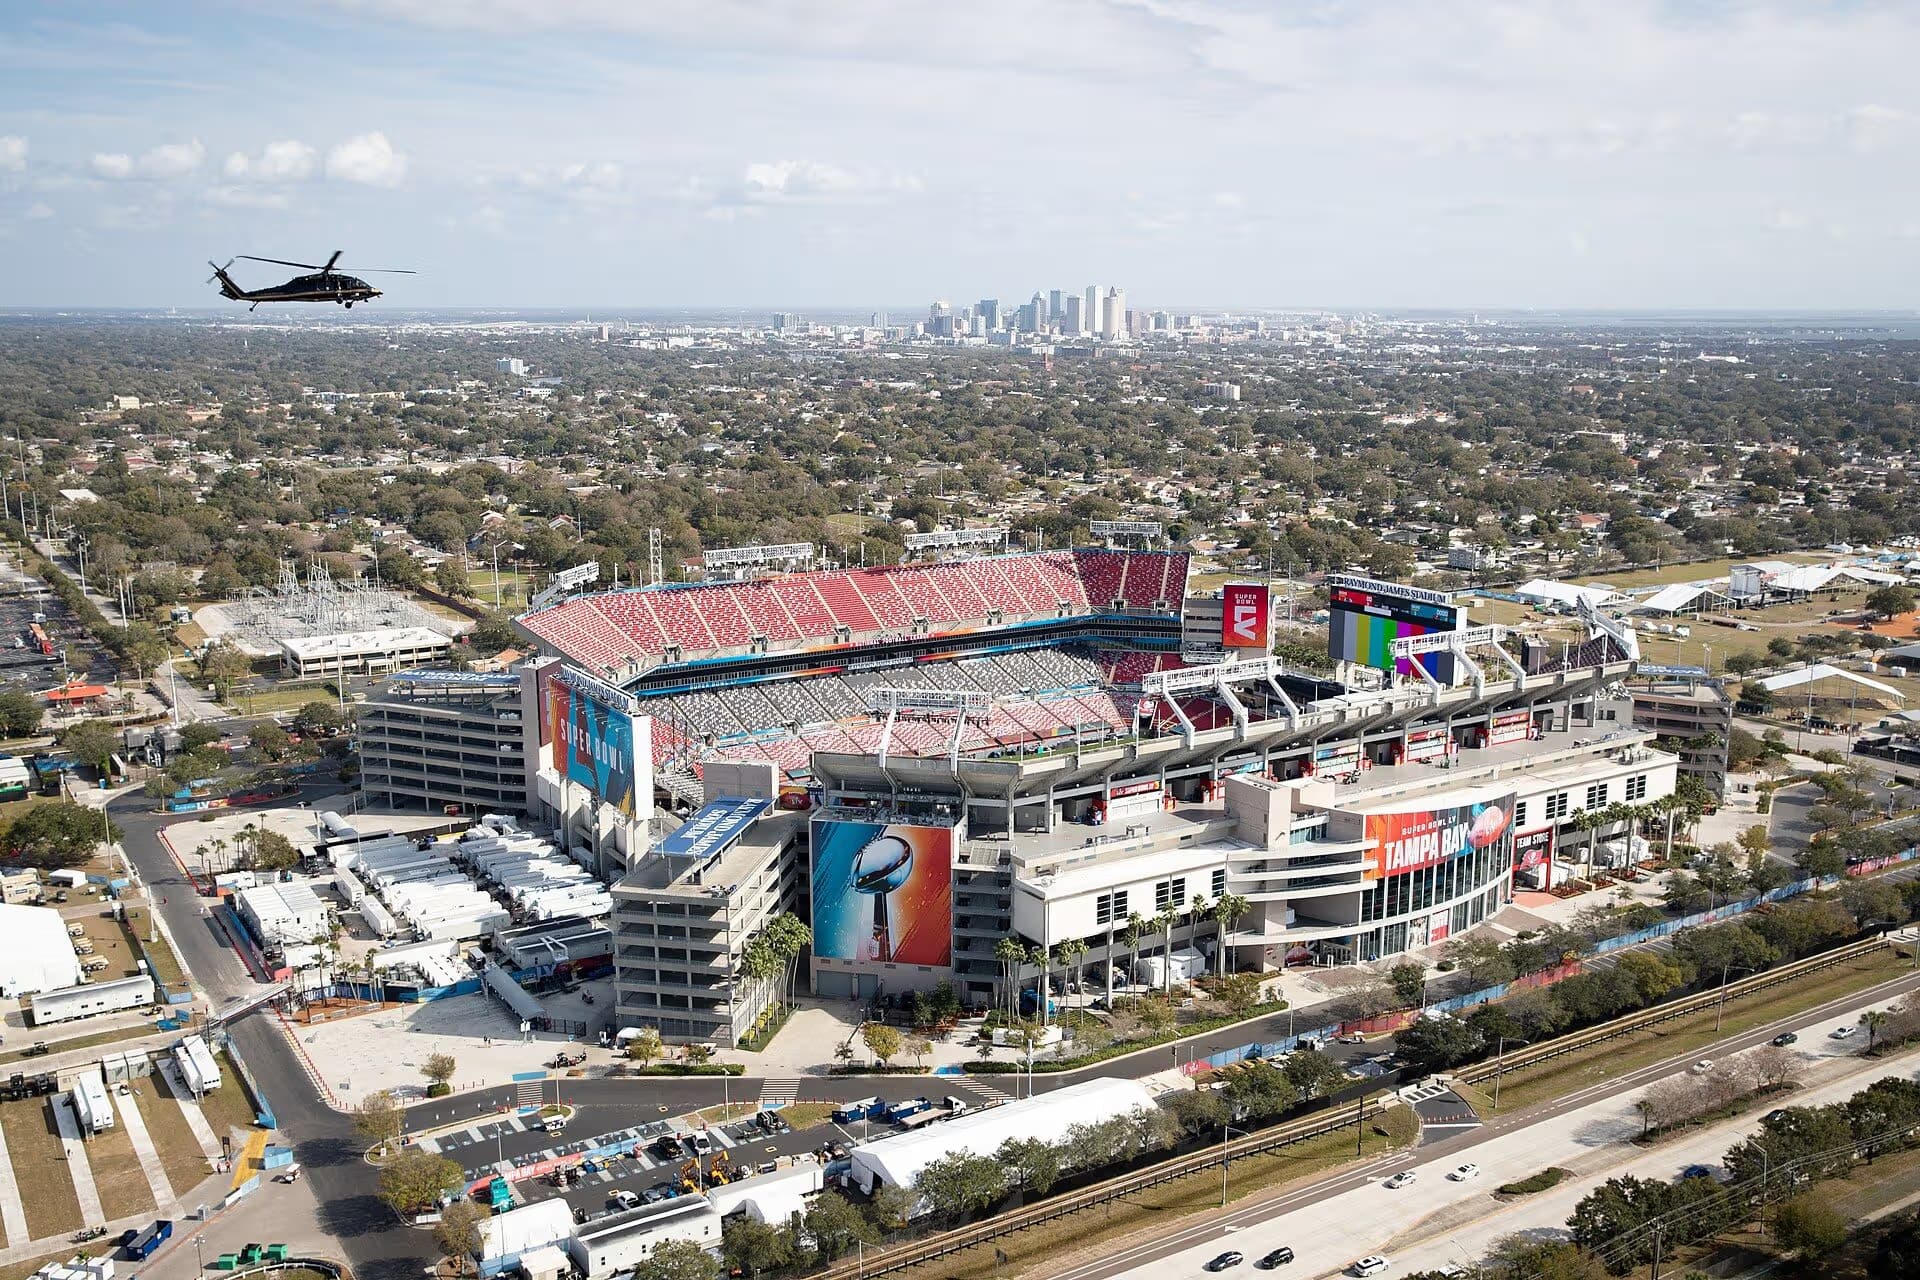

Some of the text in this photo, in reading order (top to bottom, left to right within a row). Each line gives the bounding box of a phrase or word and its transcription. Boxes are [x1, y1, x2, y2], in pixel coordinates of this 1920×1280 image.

[1344, 578, 1447, 604] RAYMOND JAMES STADIUM
[1233, 605, 1257, 641] LV
[560, 718, 624, 775] SUPER BOWL
[197, 801, 209, 810] LV
[1402, 815, 1457, 836] SUPER BOWL LV
[1384, 831, 1440, 871] TAMPA
[1441, 822, 1470, 858] BAY
[1516, 831, 1549, 849] TEAM STORE
[303, 985, 329, 1001] SUPR
